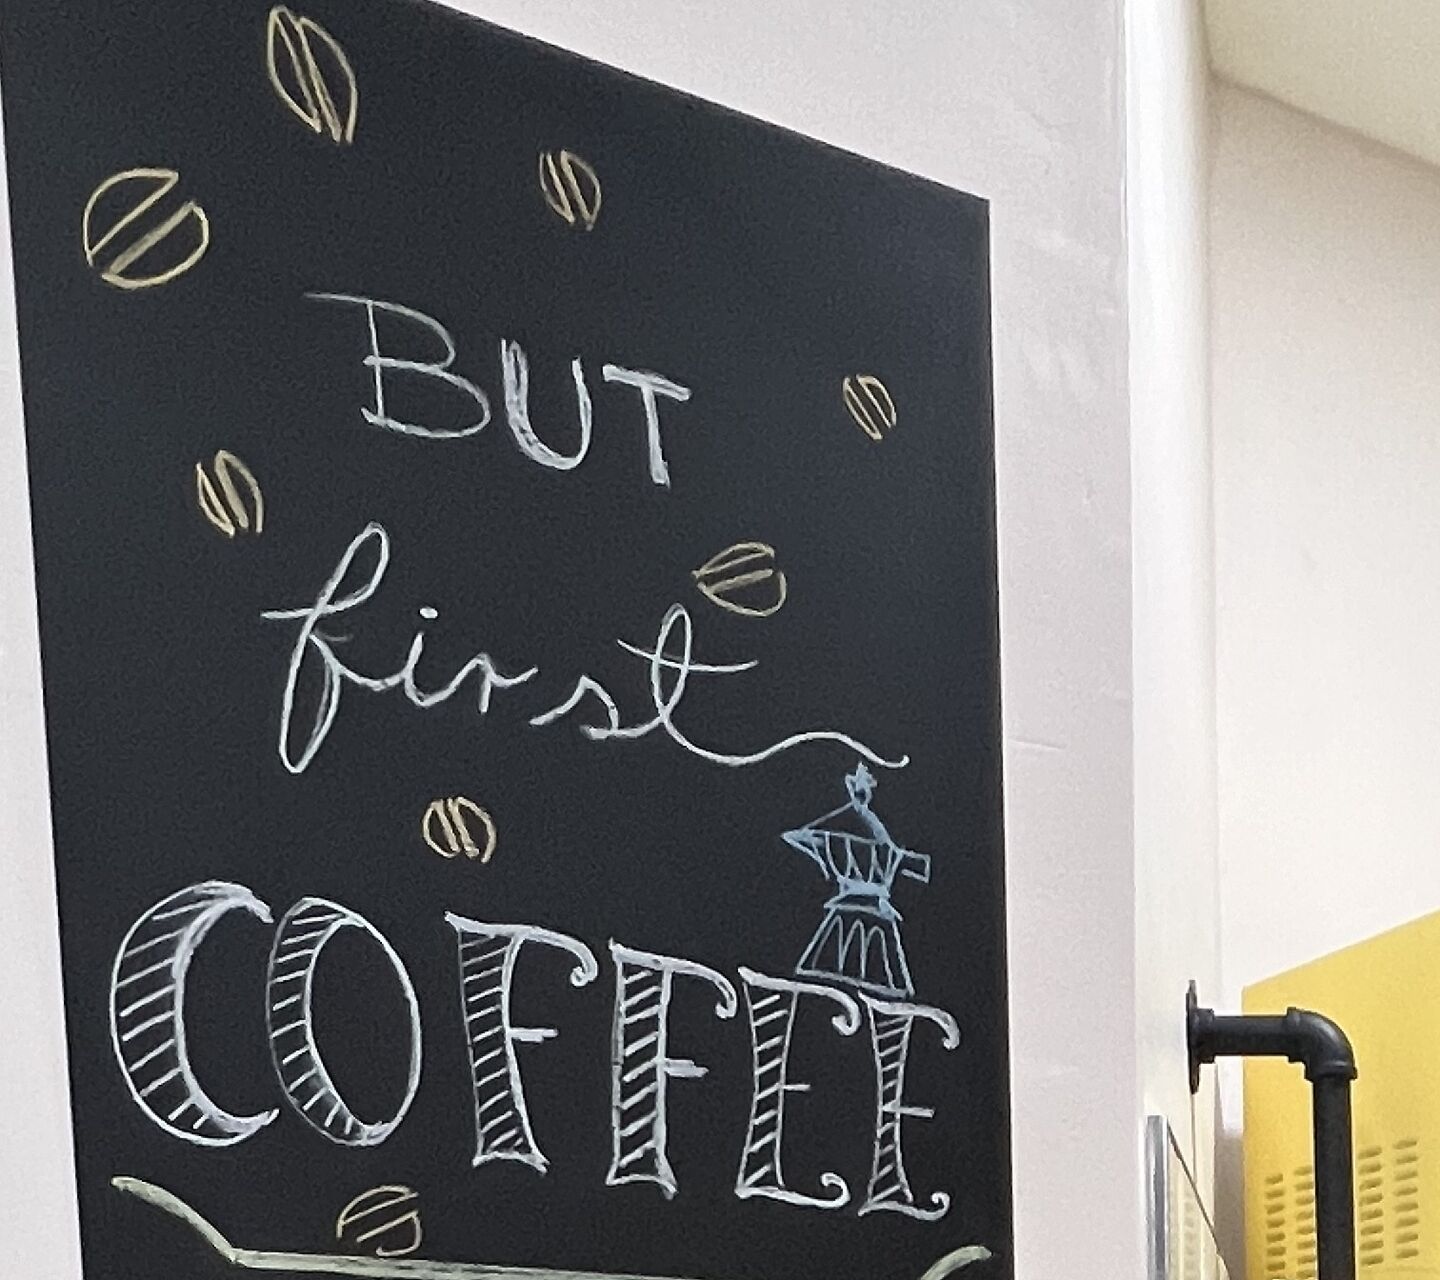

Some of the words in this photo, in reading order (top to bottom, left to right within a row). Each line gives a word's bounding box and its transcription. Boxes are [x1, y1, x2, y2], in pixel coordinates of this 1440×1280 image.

[304, 292, 690, 487] BUT
[261, 521, 908, 773] first
[110, 880, 959, 1221] COFFEE
